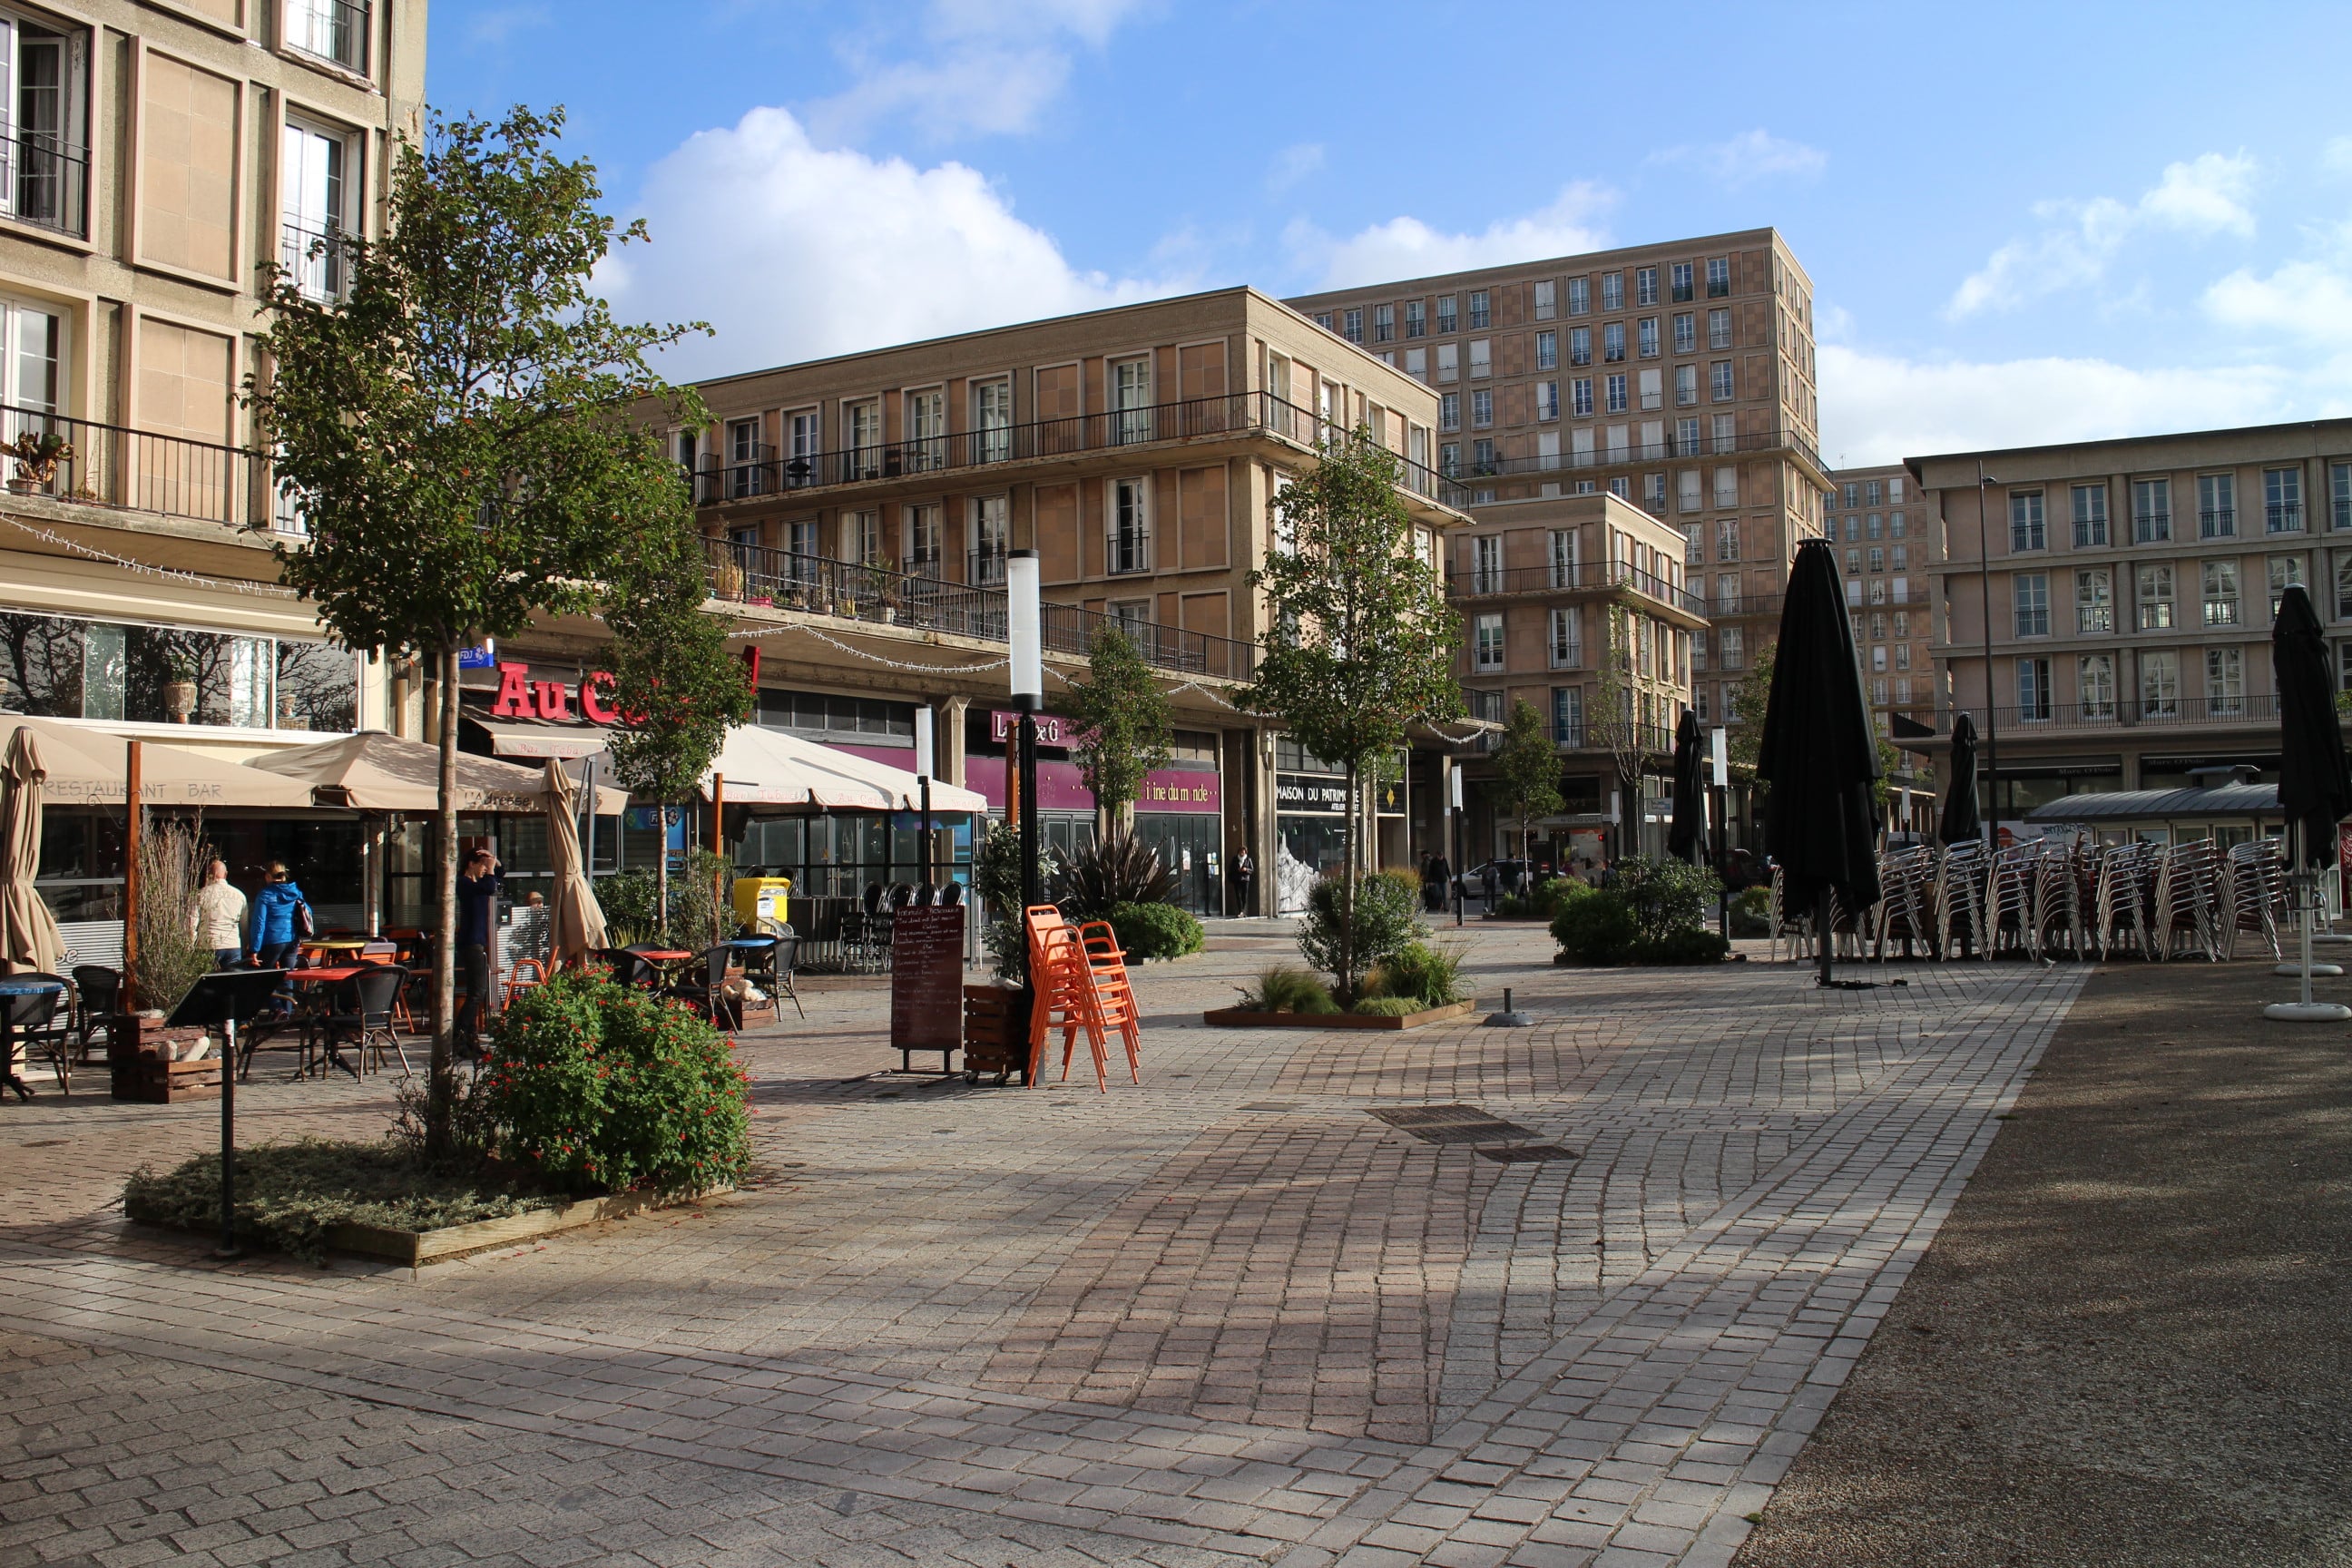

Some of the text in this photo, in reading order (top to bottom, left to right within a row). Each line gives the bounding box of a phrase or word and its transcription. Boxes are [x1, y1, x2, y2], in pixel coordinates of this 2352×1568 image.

[459, 650, 474, 660] FDJ
[490, 662, 570, 720] Au
[518, 743, 538, 754] Bar
[188, 783, 221, 799] BAR
[464, 791, 531, 807] L'Adresse
[1277, 785, 1359, 802] MAISON DU PATRIME
